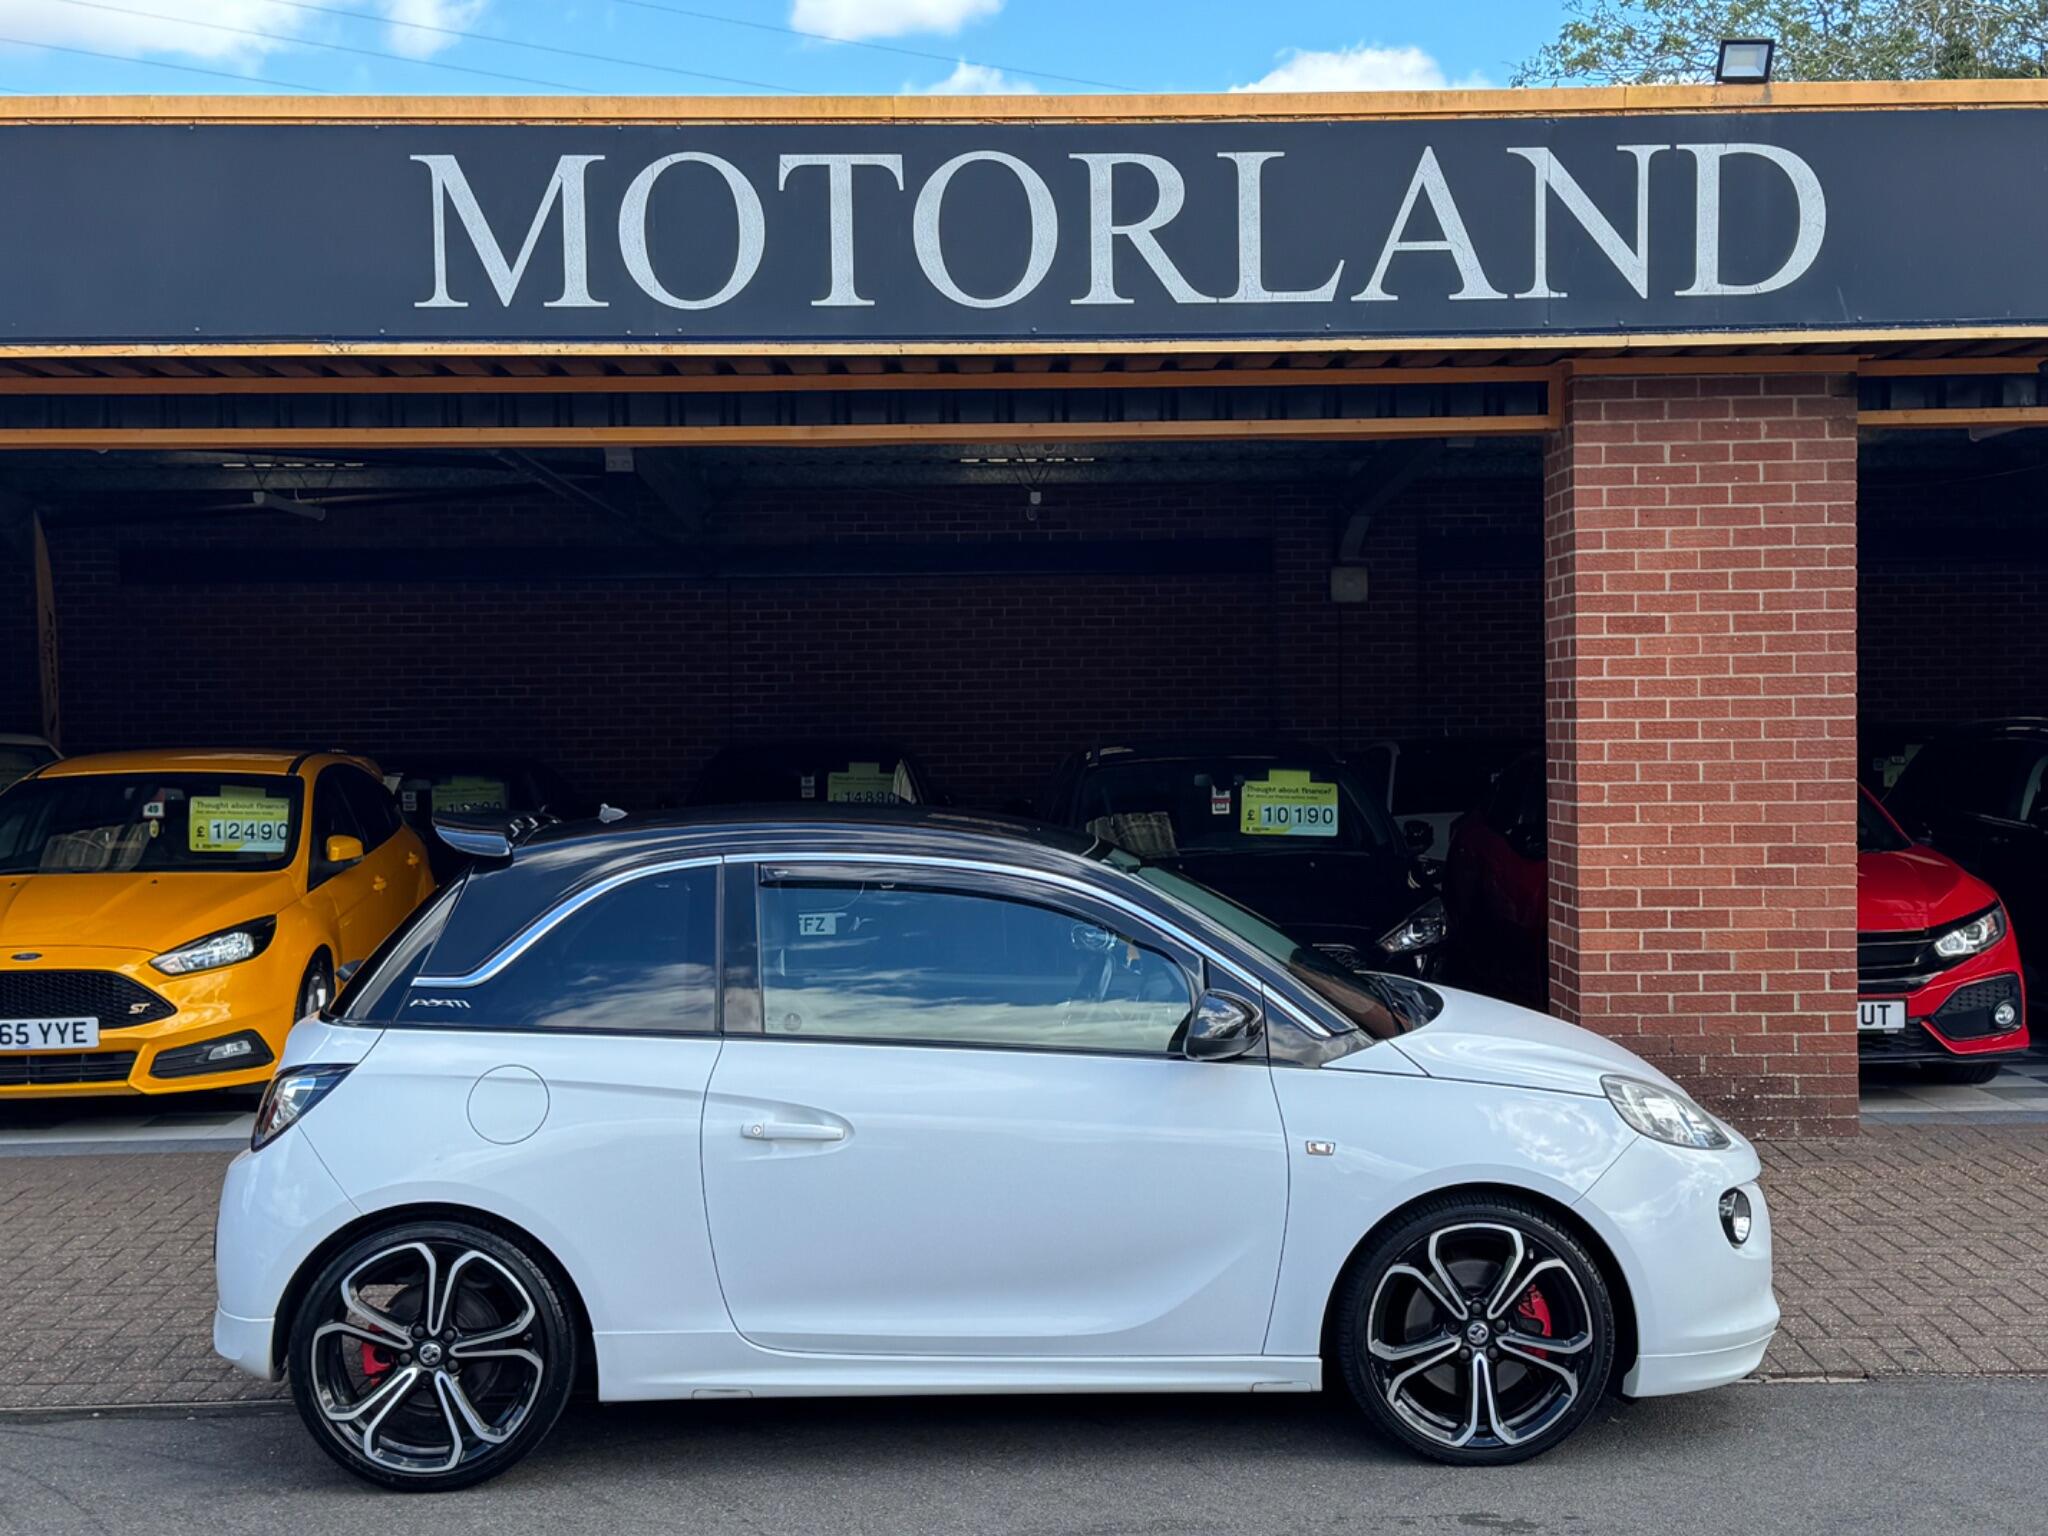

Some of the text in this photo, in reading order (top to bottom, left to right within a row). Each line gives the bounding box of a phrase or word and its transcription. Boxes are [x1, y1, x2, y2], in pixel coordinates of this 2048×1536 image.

[409, 142, 1827, 311] MOTORLAND
[1247, 785, 1276, 794] Thought
[1264, 806, 1334, 824] 10190
[213, 822, 288, 840] 12490
[800, 917, 826, 933] FZ
[128, 1003, 150, 1015] ST
[1861, 1004, 1891, 1026] UT
[0, 1022, 88, 1045] 65 YYE
